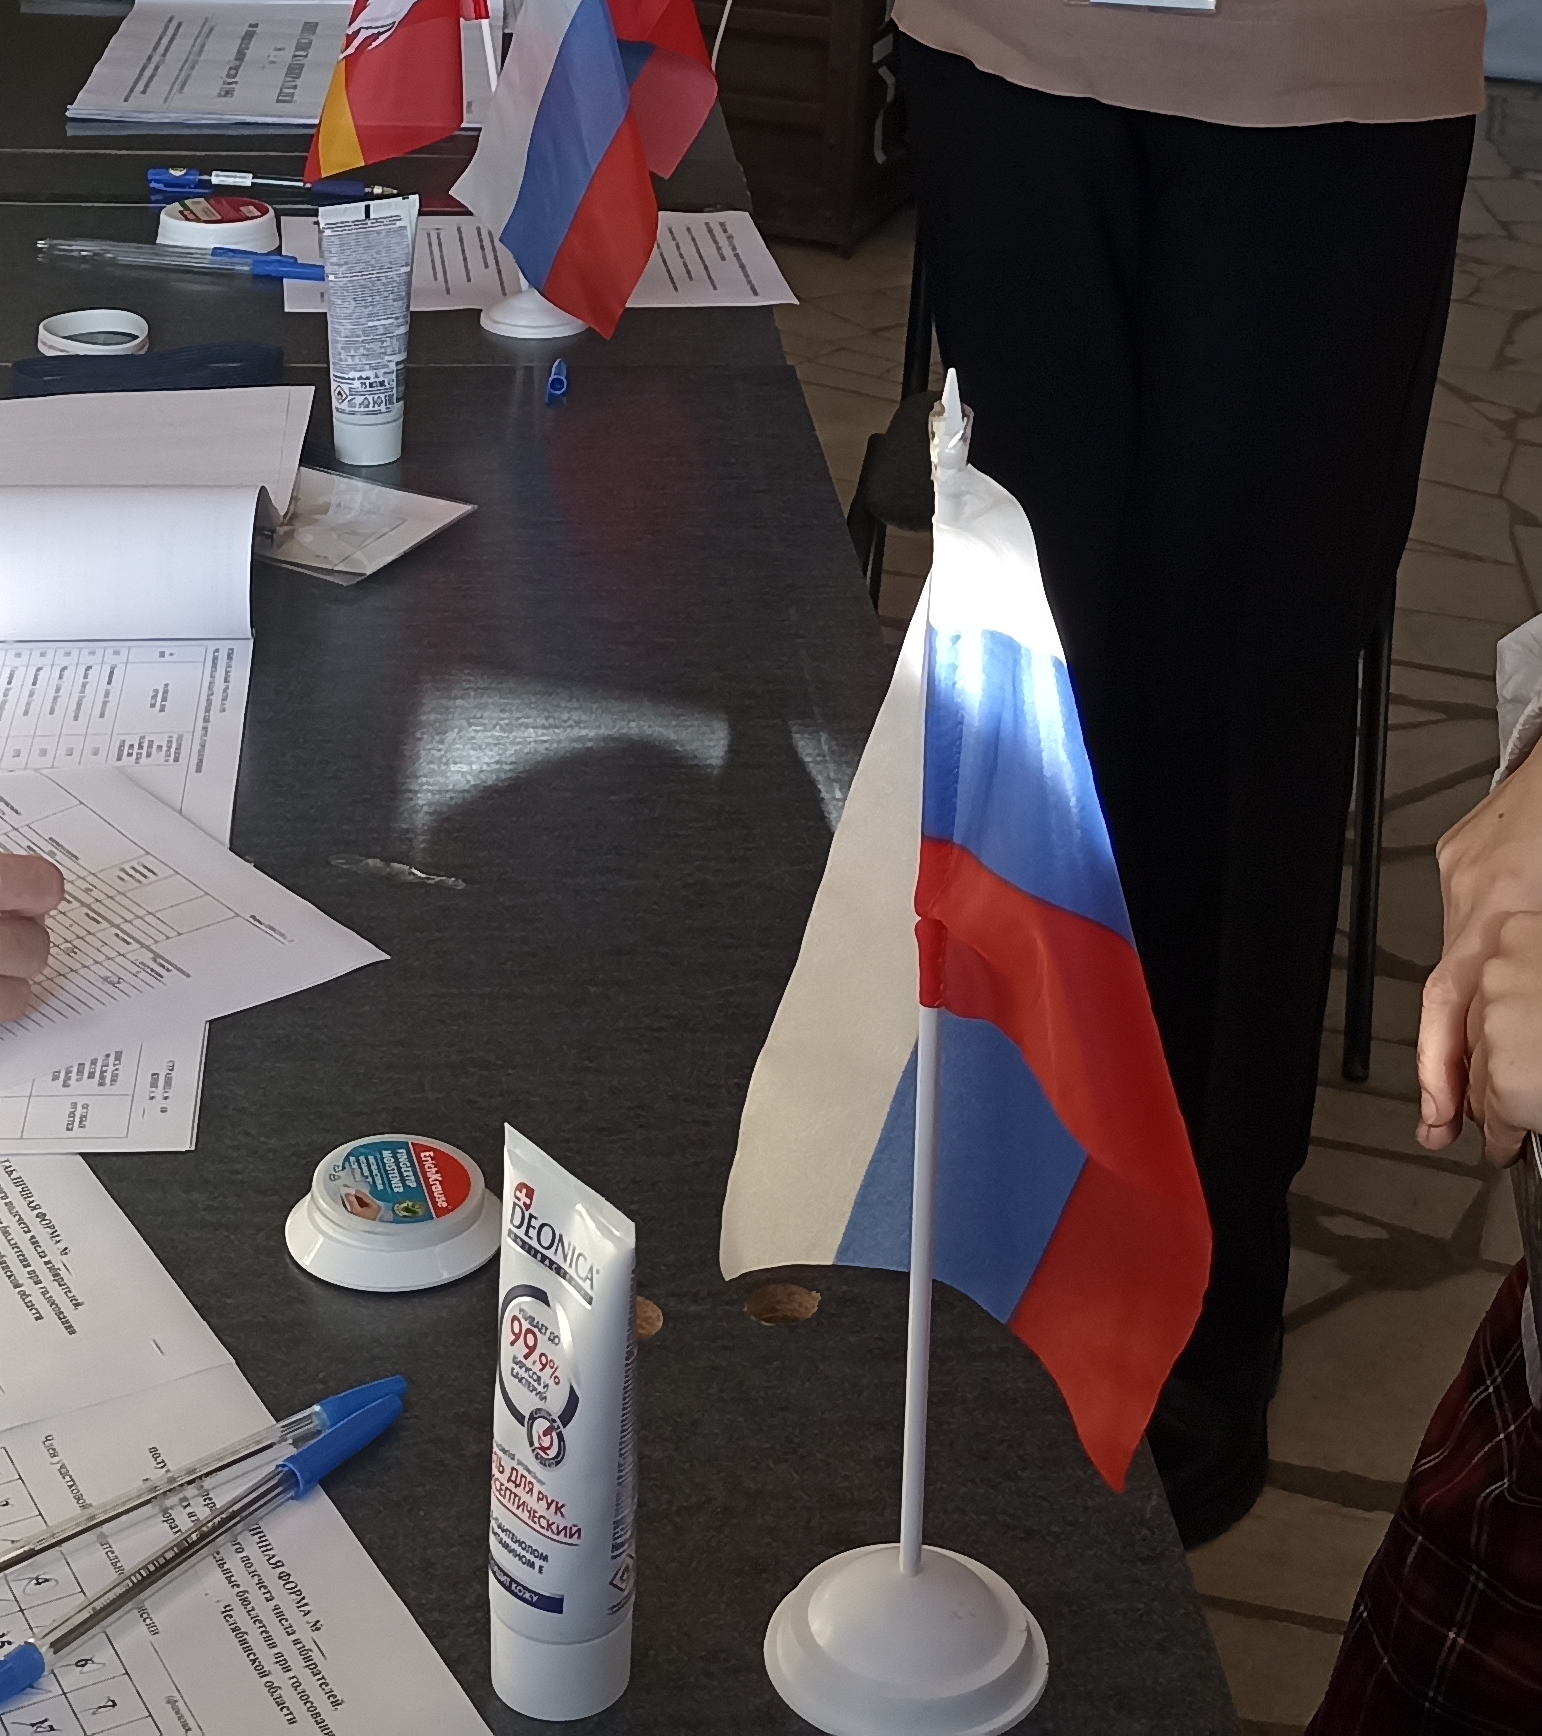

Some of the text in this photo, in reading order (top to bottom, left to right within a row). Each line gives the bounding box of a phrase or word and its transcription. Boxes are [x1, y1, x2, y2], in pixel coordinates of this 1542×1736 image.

[382, 1150, 404, 1193] MOISTENER
[396, 1148, 417, 1188] FINGERTIP
[420, 1151, 448, 1209] ErichKrause
[0, 1157, 42, 1212] ТАБЛИЧНАЯ
[34, 1211, 62, 1245] ФОРМА
[510, 1201, 594, 1291] DEONICA
[548, 1330, 561, 1346] ДО
[41, 1433, 59, 1459] Член
[507, 1466, 534, 1496] ДЛЯ
[537, 1490, 566, 1519] РУК
[276, 1570, 312, 1617] ФОРМА
[305, 1618, 323, 1632] №
[511, 1581, 538, 1603] КОЖУ
[235, 1589, 278, 1649] бюллетени
[272, 1650, 292, 1673] при
[239, 1554, 345, 1711] подсчета числа избирателей,
[220, 1603, 298, 1725] Челябинской области
